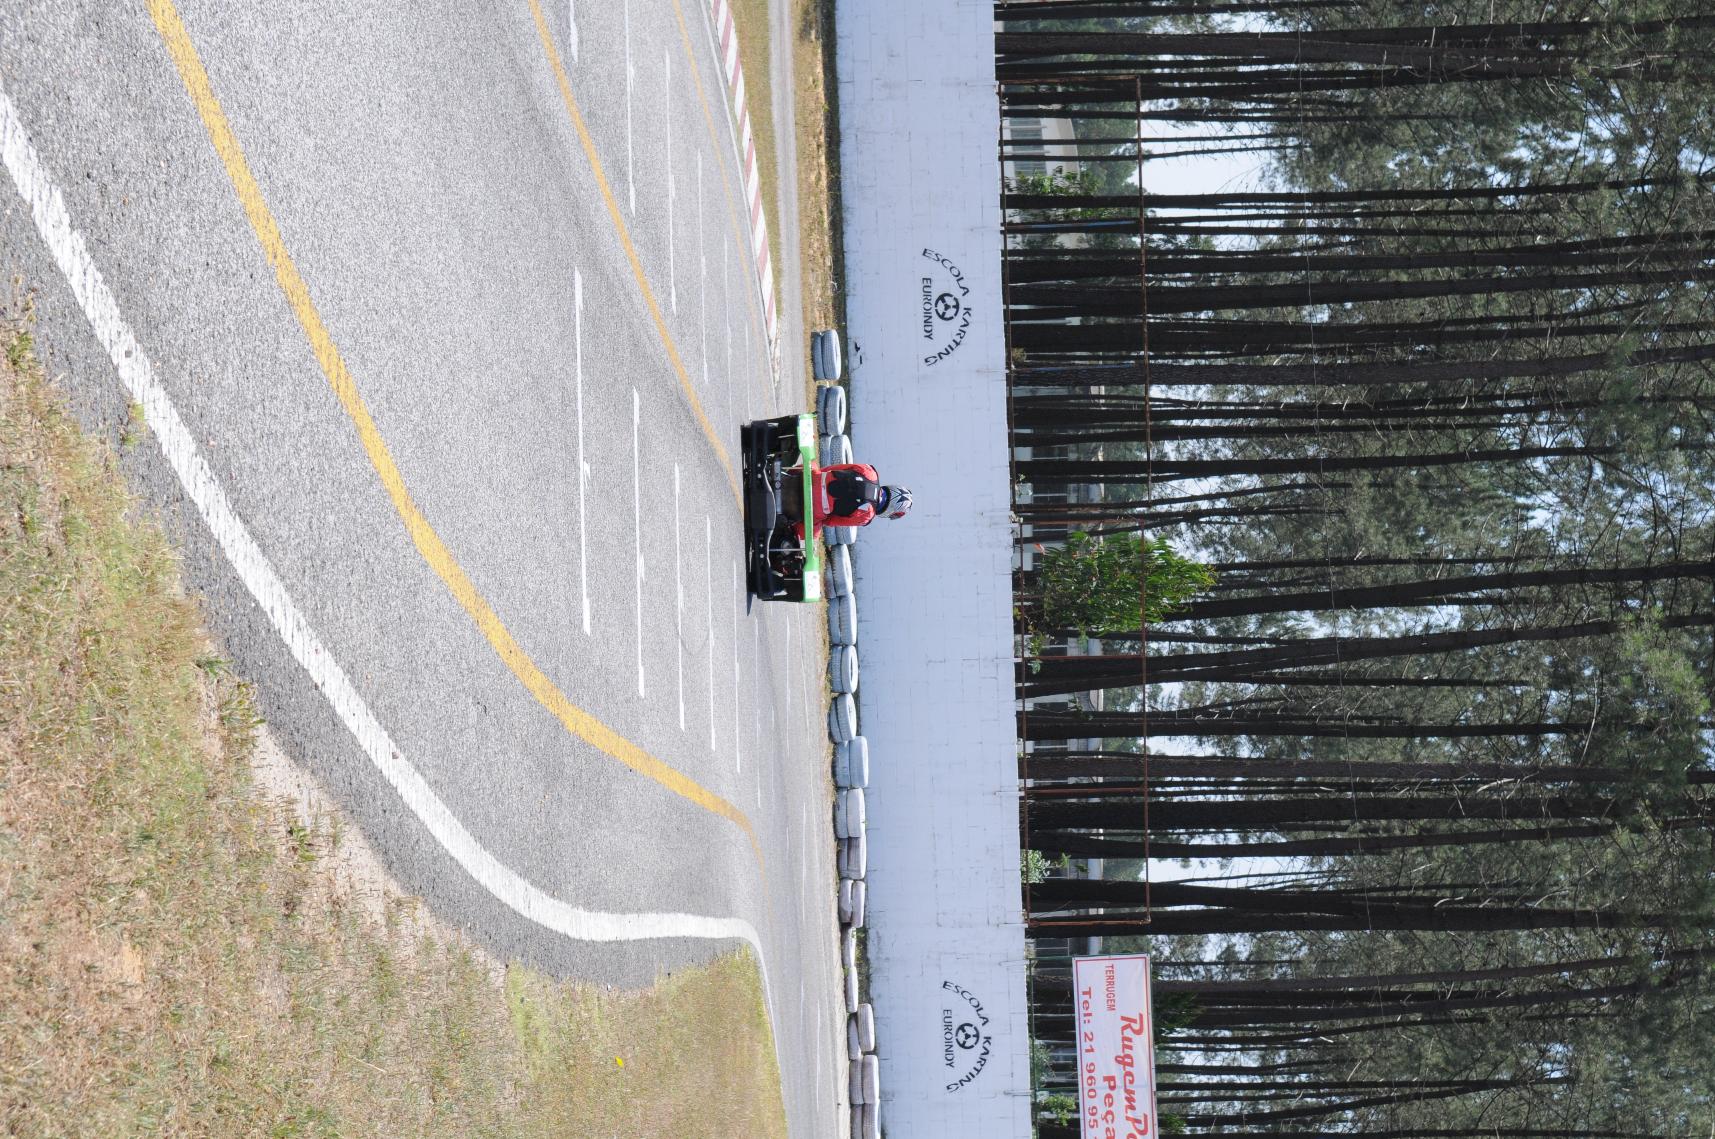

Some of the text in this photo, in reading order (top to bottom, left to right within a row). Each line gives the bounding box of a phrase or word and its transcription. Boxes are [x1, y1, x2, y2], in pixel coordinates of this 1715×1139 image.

[922, 248, 972, 367] ESCOLA KARTING
[922, 277, 934, 340] EUROINDY
[1081, 986, 1093, 1025] Tel:
[1105, 964, 1116, 1012] TERRUGEM
[943, 980, 992, 1093] ESCOLA KARTING
[943, 1009, 955, 1068] EUROINDY
[1083, 1031, 1095, 1054] 21
[1085, 1062, 1097, 1099] 960
[1088, 1105, 1099, 1129] 95
